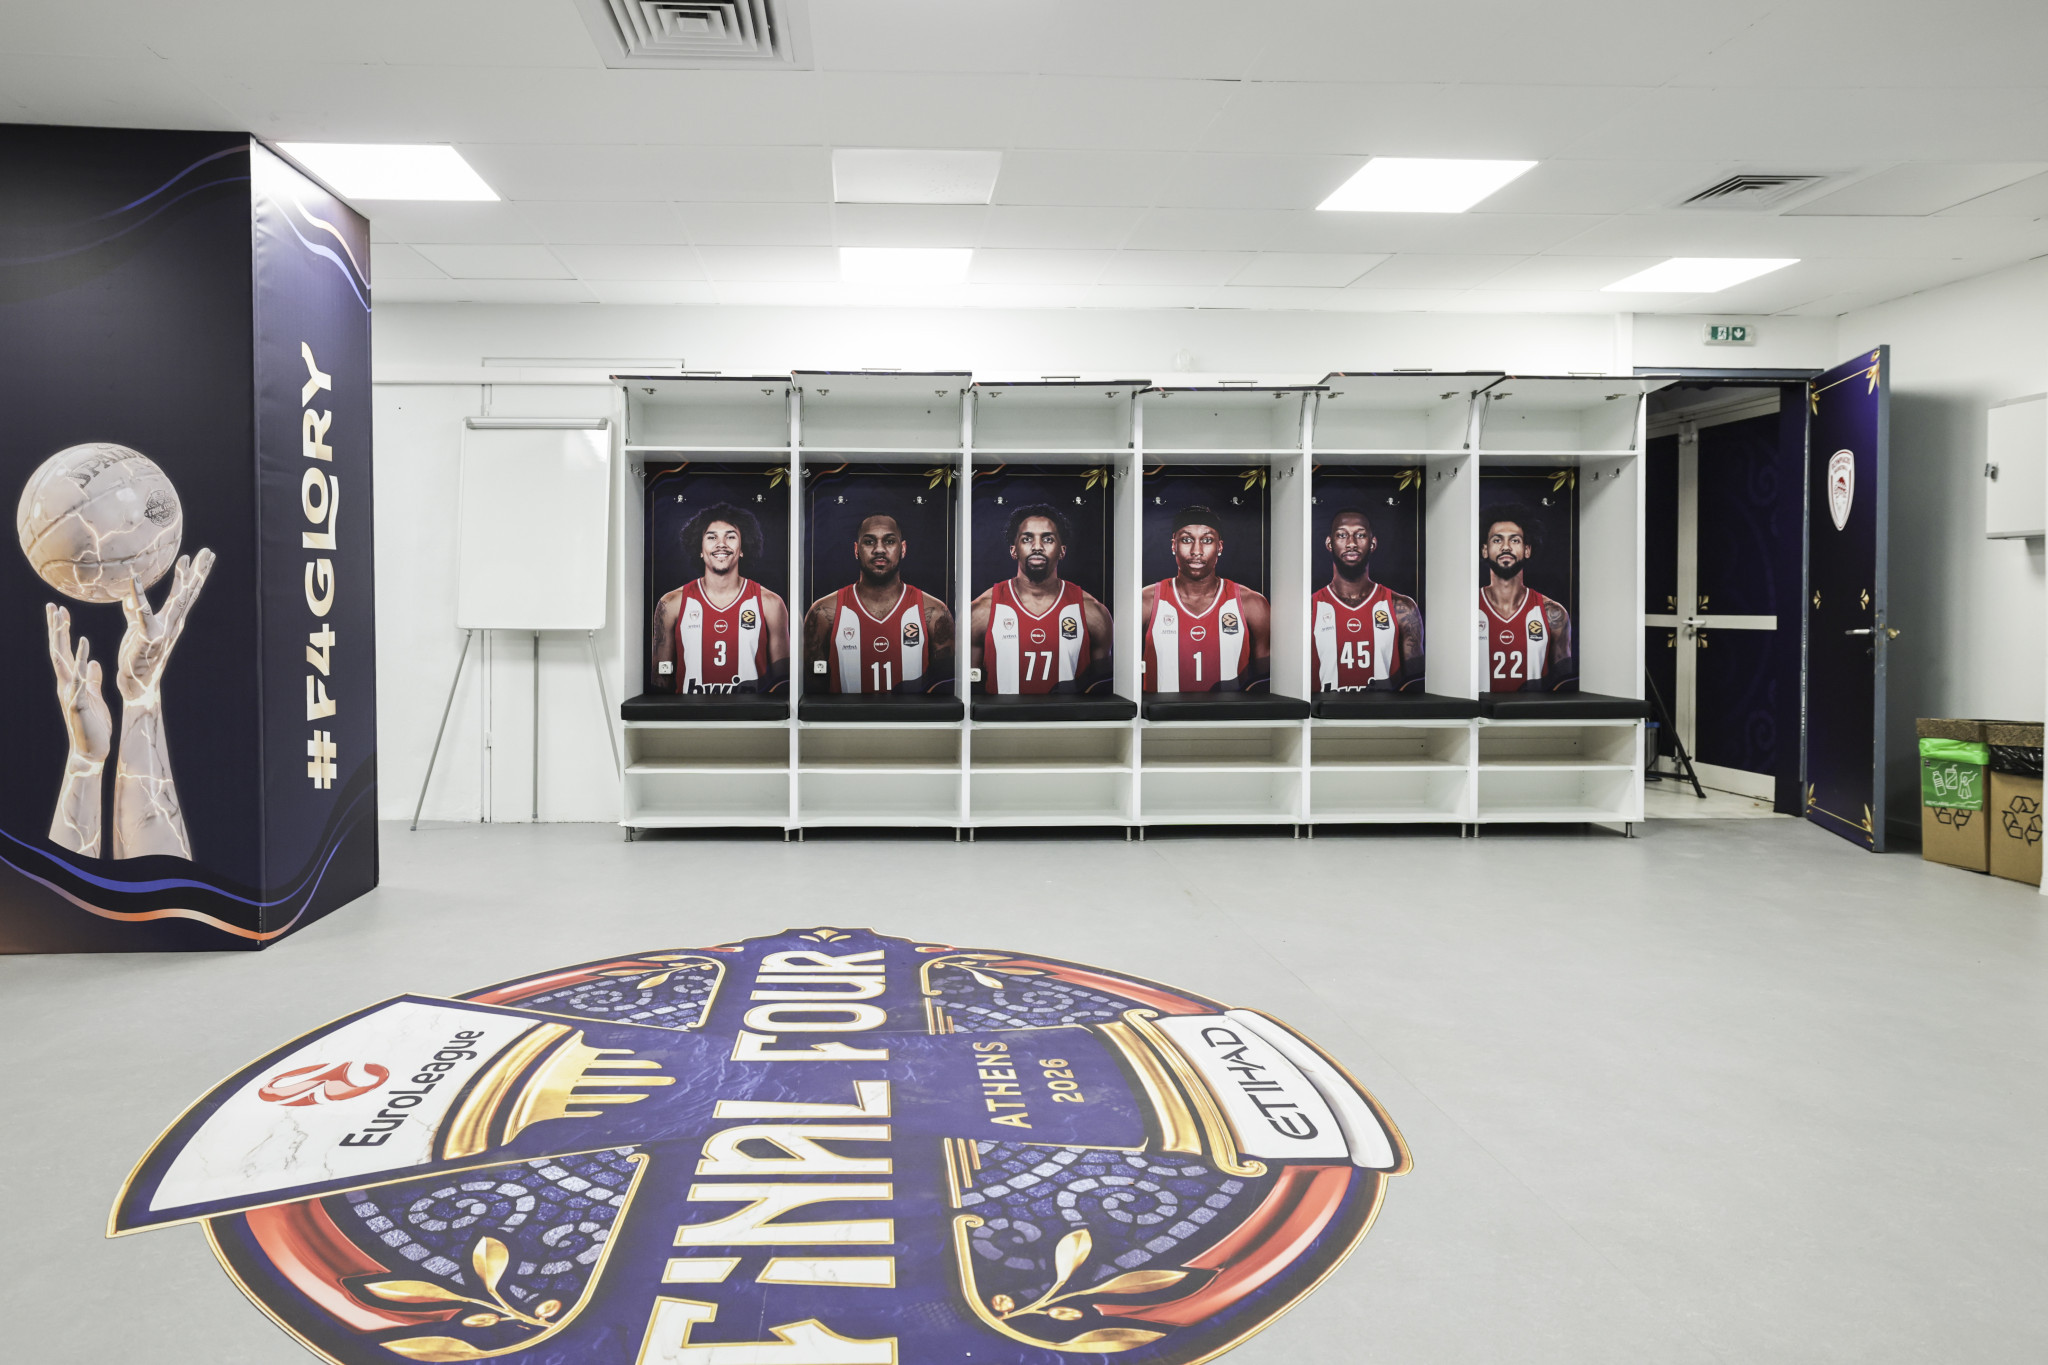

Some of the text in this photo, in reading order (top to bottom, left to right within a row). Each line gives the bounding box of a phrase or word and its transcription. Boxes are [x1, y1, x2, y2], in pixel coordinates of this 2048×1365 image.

[301, 341, 340, 789] #F4GLORY
[713, 640, 727, 666] 3
[1024, 651, 1053, 681] 77
[1193, 651, 1202, 682] 1
[1340, 641, 1370, 669] 45
[1493, 650, 1523, 679] 22
[687, 677, 756, 695] bwi
[871, 661, 892, 691] 11
[338, 1030, 485, 1147] EuroLeague
[972, 1041, 1033, 1129] ATHENS
[1038, 1058, 1085, 1103] 2026
[1200, 1027, 1319, 1140] ETIHAD
[635, 949, 898, 1365] FINAL FOUR
